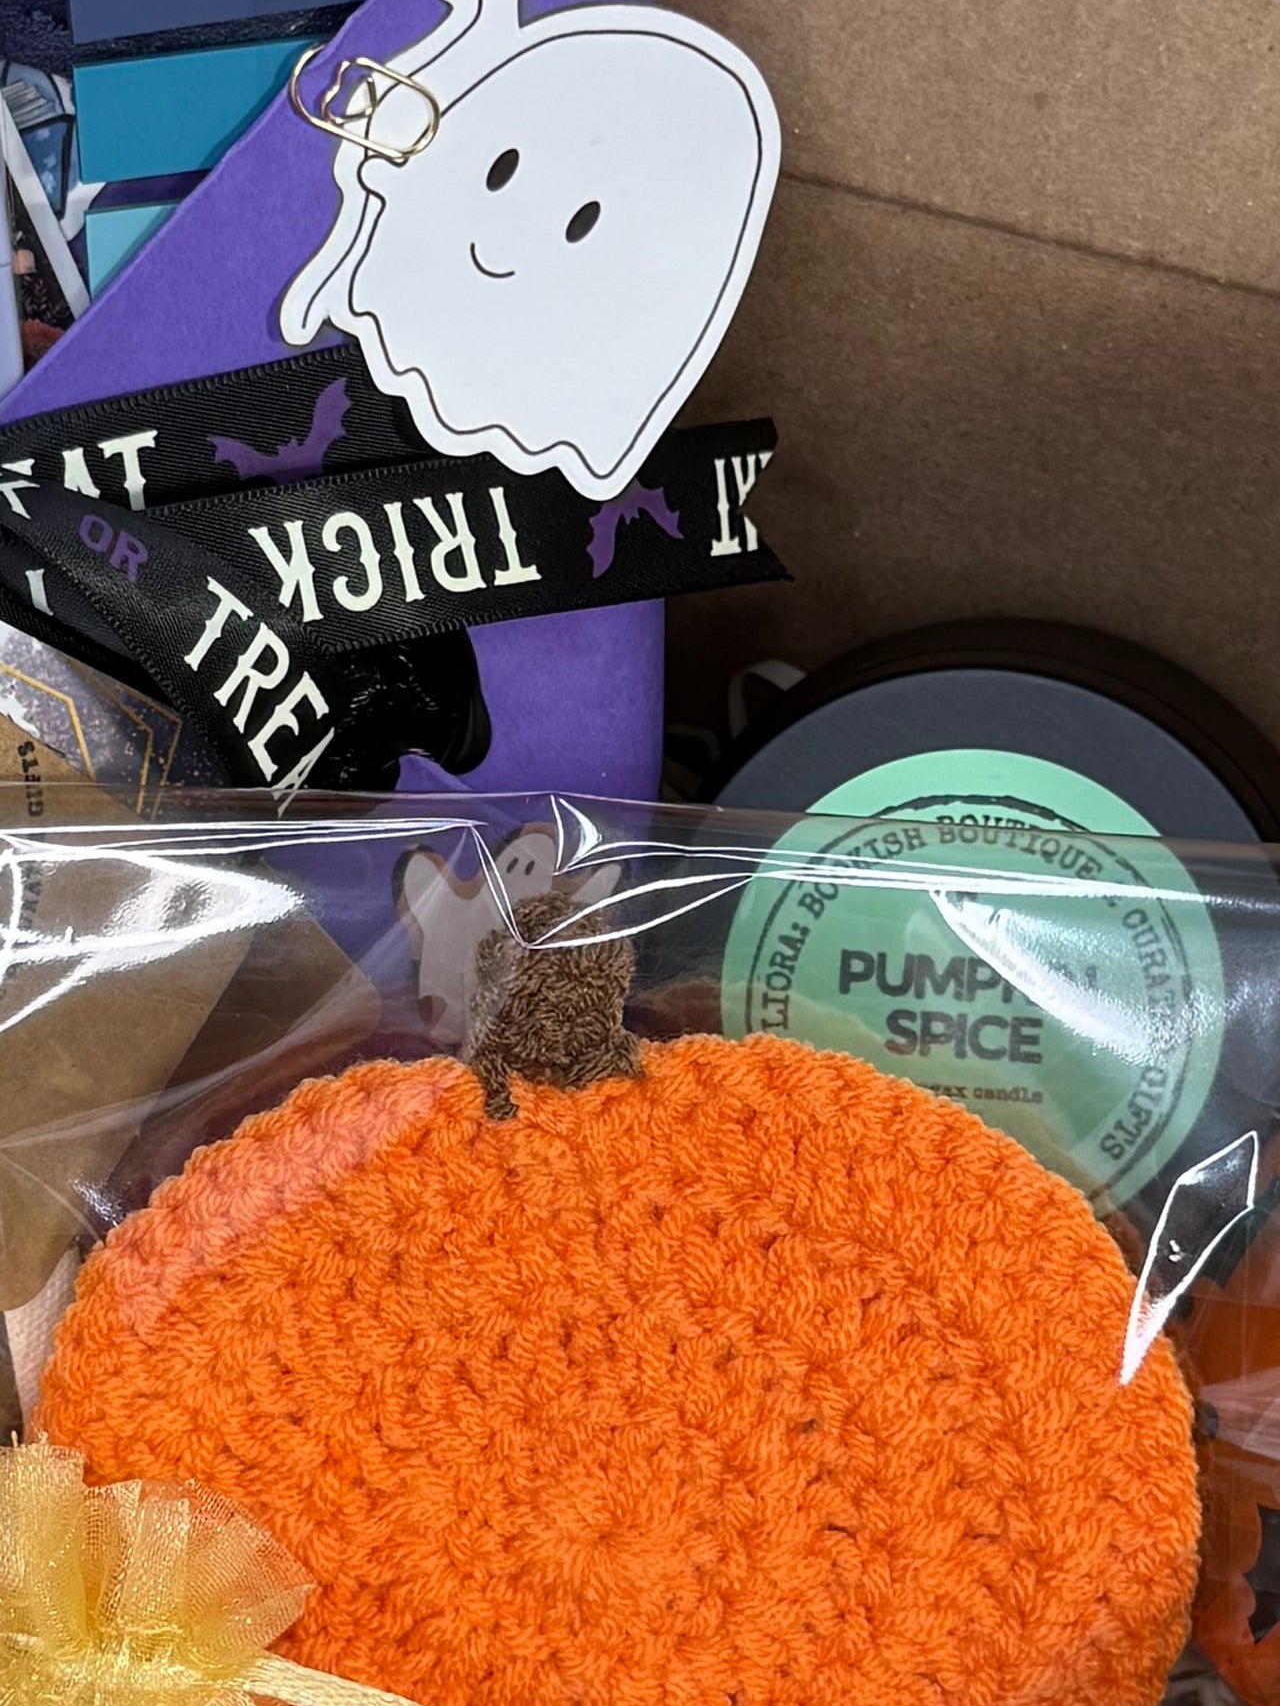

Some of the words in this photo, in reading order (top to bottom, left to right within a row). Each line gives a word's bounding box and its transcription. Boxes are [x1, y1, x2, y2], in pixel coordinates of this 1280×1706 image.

[78, 514, 149, 583] OR
[247, 486, 543, 622] TRICK
[884, 1008, 1043, 1064] SPICE
[972, 1086, 1045, 1105] candle
